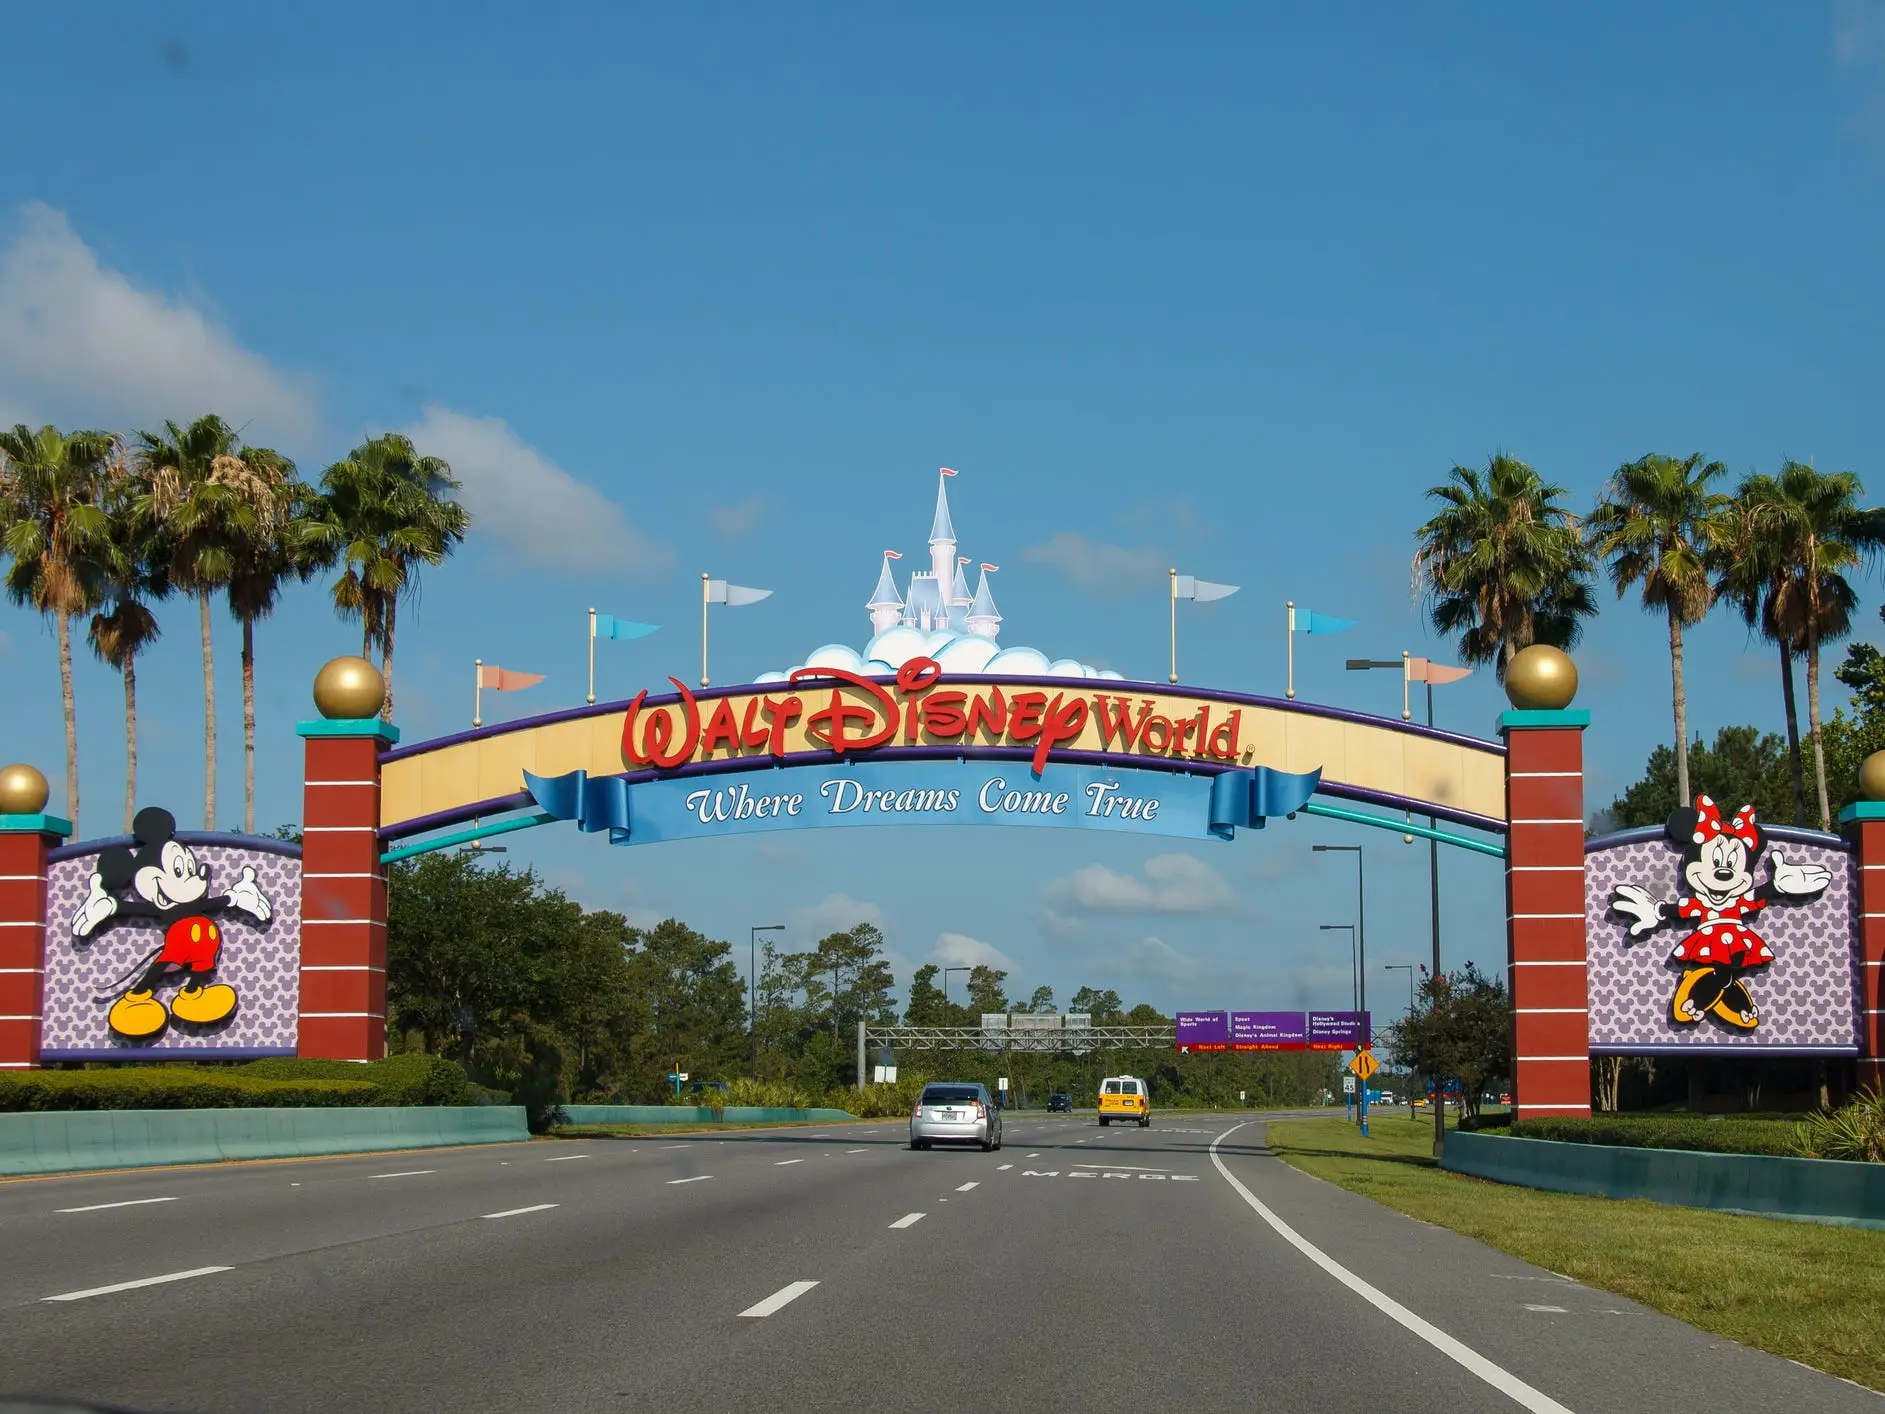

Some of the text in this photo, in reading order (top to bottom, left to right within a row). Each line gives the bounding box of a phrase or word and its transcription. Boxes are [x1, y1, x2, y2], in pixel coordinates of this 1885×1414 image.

[623, 656, 1242, 777] Walt Disney World
[685, 777, 1161, 824] Where Dreams Come True
[1021, 1170, 1200, 1181] MERGE
